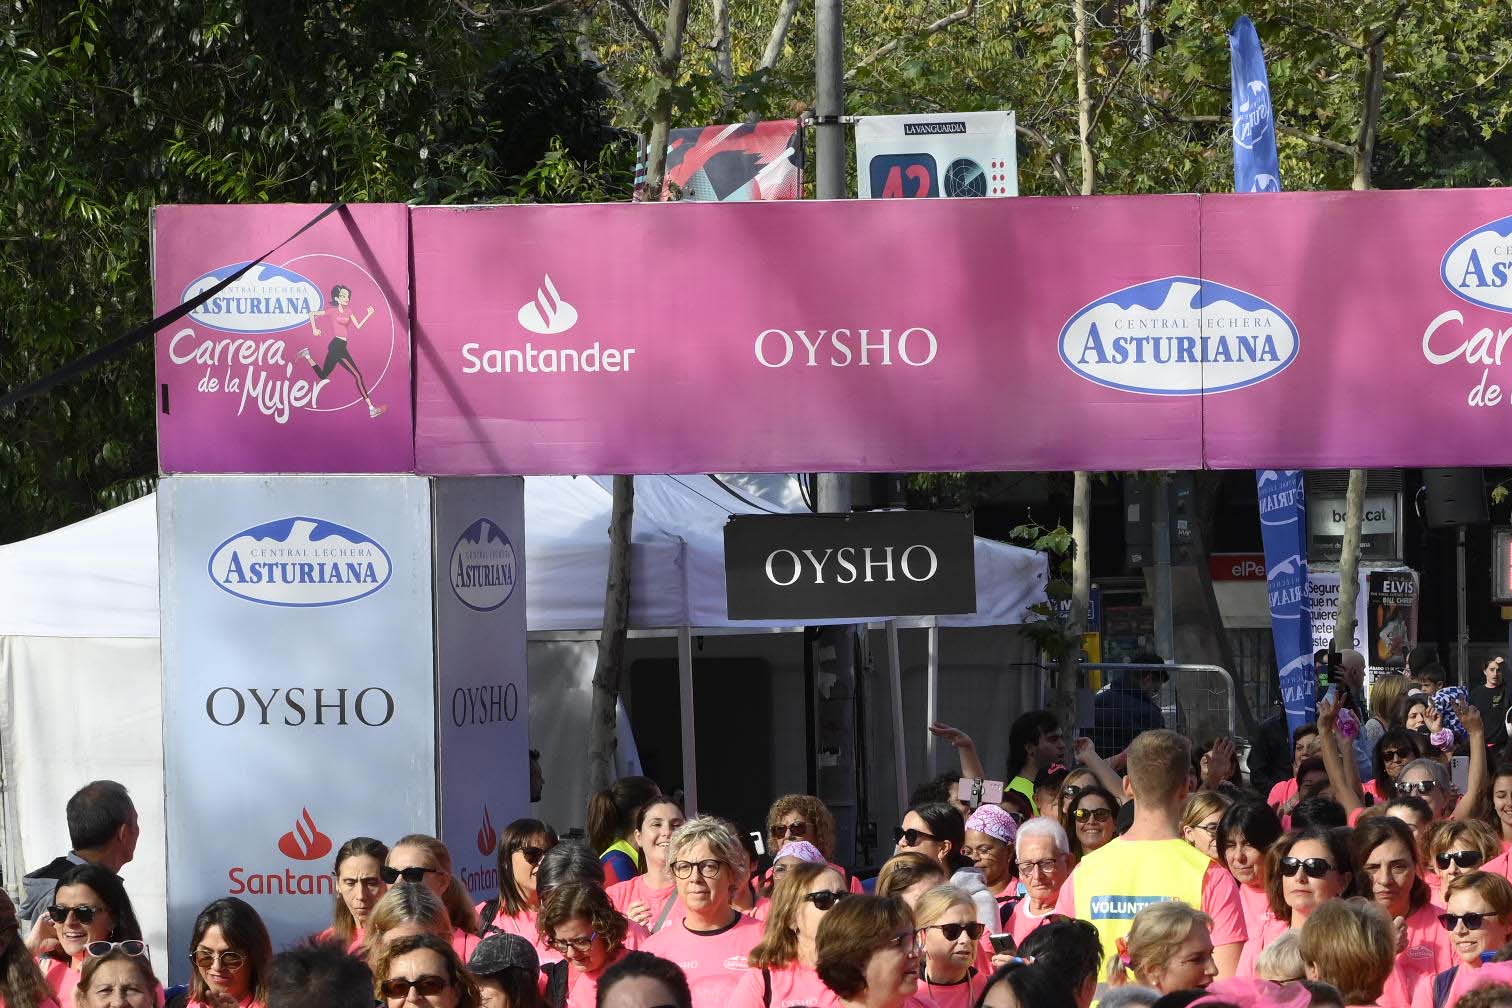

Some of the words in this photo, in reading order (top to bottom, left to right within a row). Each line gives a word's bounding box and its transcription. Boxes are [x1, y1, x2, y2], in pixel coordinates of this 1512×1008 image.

[1114, 318, 1189, 330] CENTRAL
[169, 328, 286, 366] Carrera
[462, 342, 636, 374] Santander
[754, 327, 939, 368] OYSHO
[1077, 321, 1281, 365] ASTURIANA
[198, 367, 219, 393] de
[225, 366, 240, 393] la
[238, 362, 330, 424] Mujer
[1467, 369, 1503, 408] de
[223, 550, 380, 585] ASTURIANA
[250, 548, 309, 558] CENTRAL
[315, 547, 374, 558] LECHERA
[455, 552, 514, 589] ASTURIANA
[764, 543, 939, 587] OYSHO
[1383, 581, 1414, 593] ELVIS
[205, 686, 396, 728] OYSHO
[452, 682, 519, 728] OYSHO
[228, 866, 336, 895] Santan
[460, 864, 499, 892] Santan
[1091, 902, 1150, 914] VOLUNT
